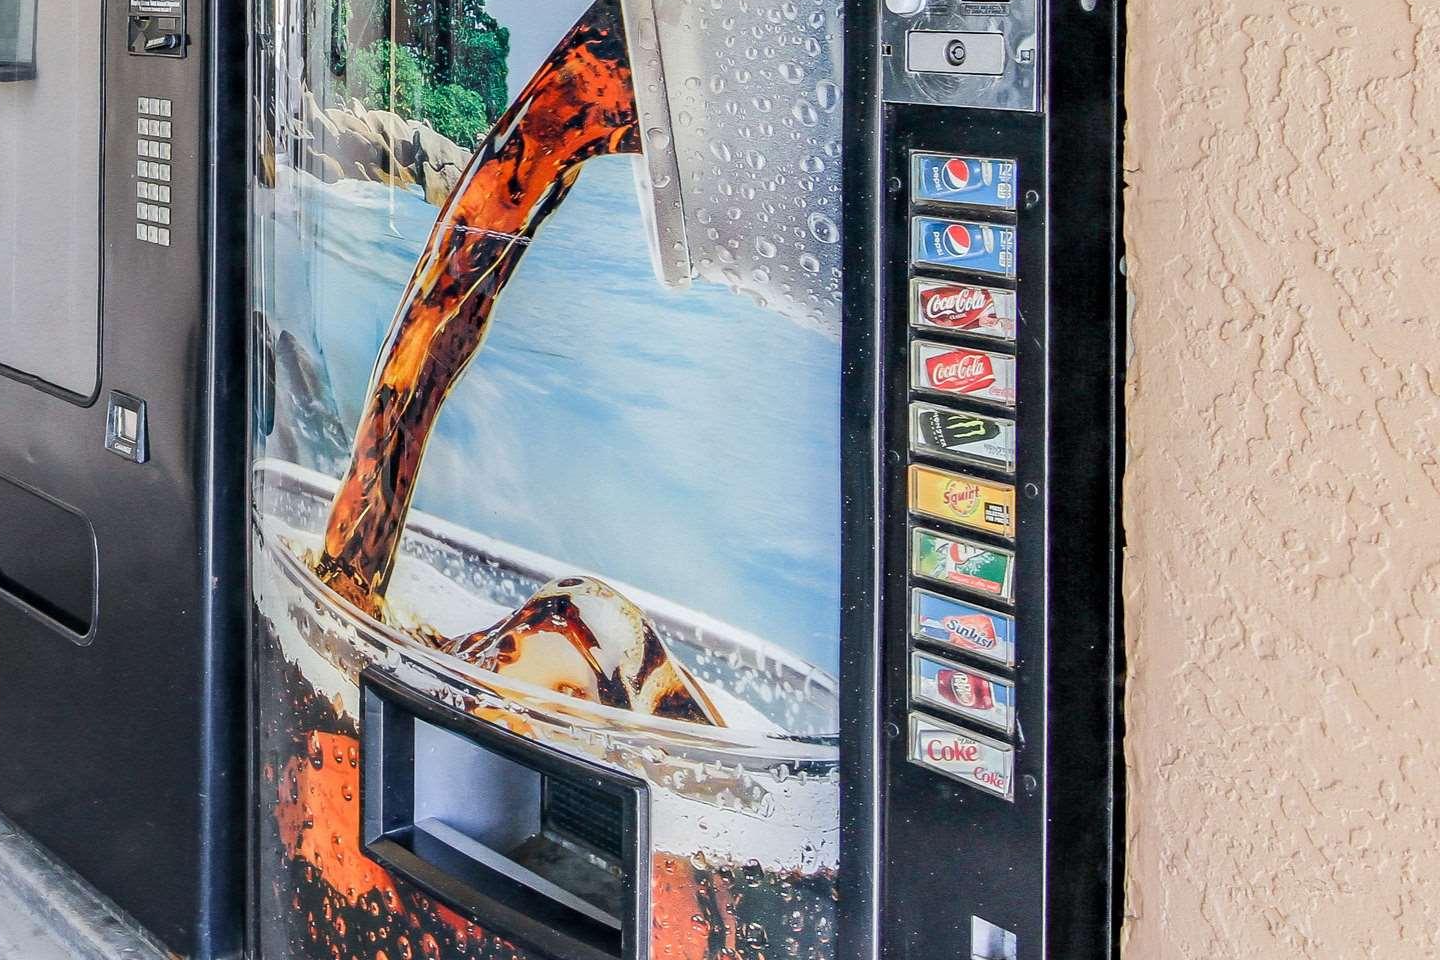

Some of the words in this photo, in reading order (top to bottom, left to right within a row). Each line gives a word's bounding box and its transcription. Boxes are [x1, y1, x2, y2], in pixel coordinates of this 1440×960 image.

[943, 485, 980, 508] Squirt
[947, 619, 993, 648] Sunkist
[927, 739, 980, 761] Coke
[974, 766, 1005, 789] Coke
